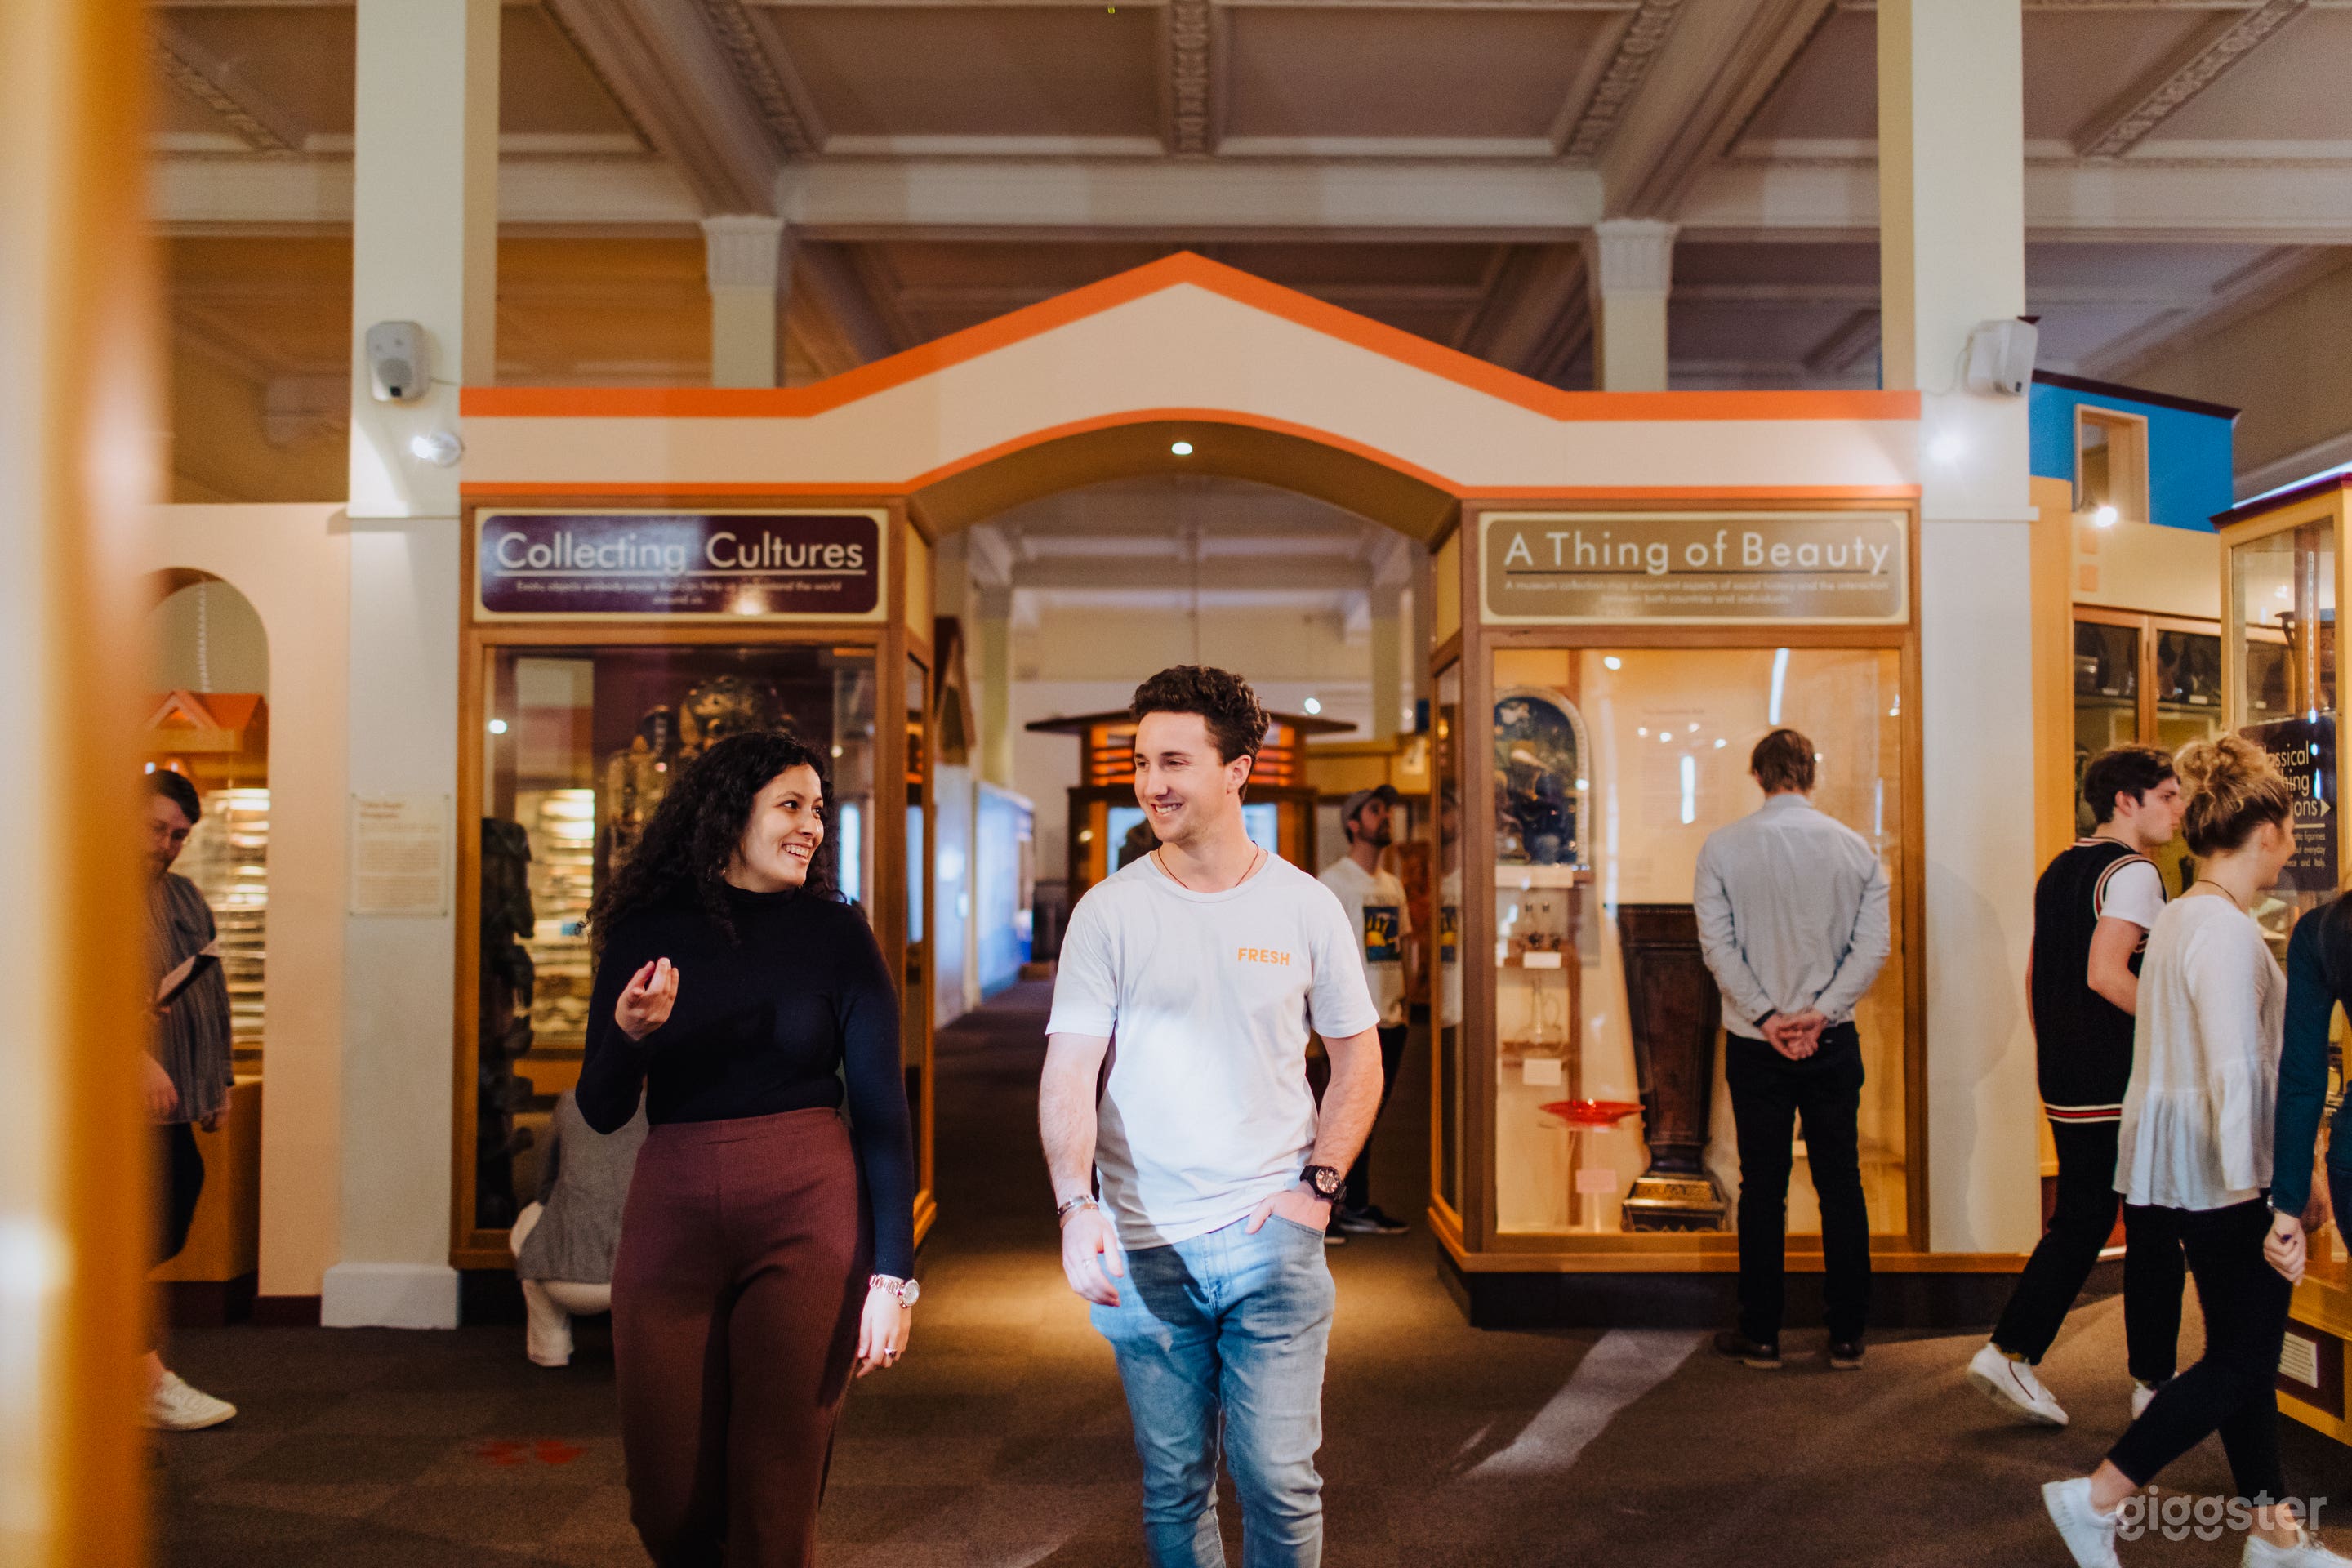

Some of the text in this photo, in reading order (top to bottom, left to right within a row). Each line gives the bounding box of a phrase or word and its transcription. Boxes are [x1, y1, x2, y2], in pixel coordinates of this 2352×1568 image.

[496, 531, 864, 574] Collecting Cultures
[1503, 528, 1890, 575] A Thing of Beauty
[1237, 947, 1290, 966] FRESH
